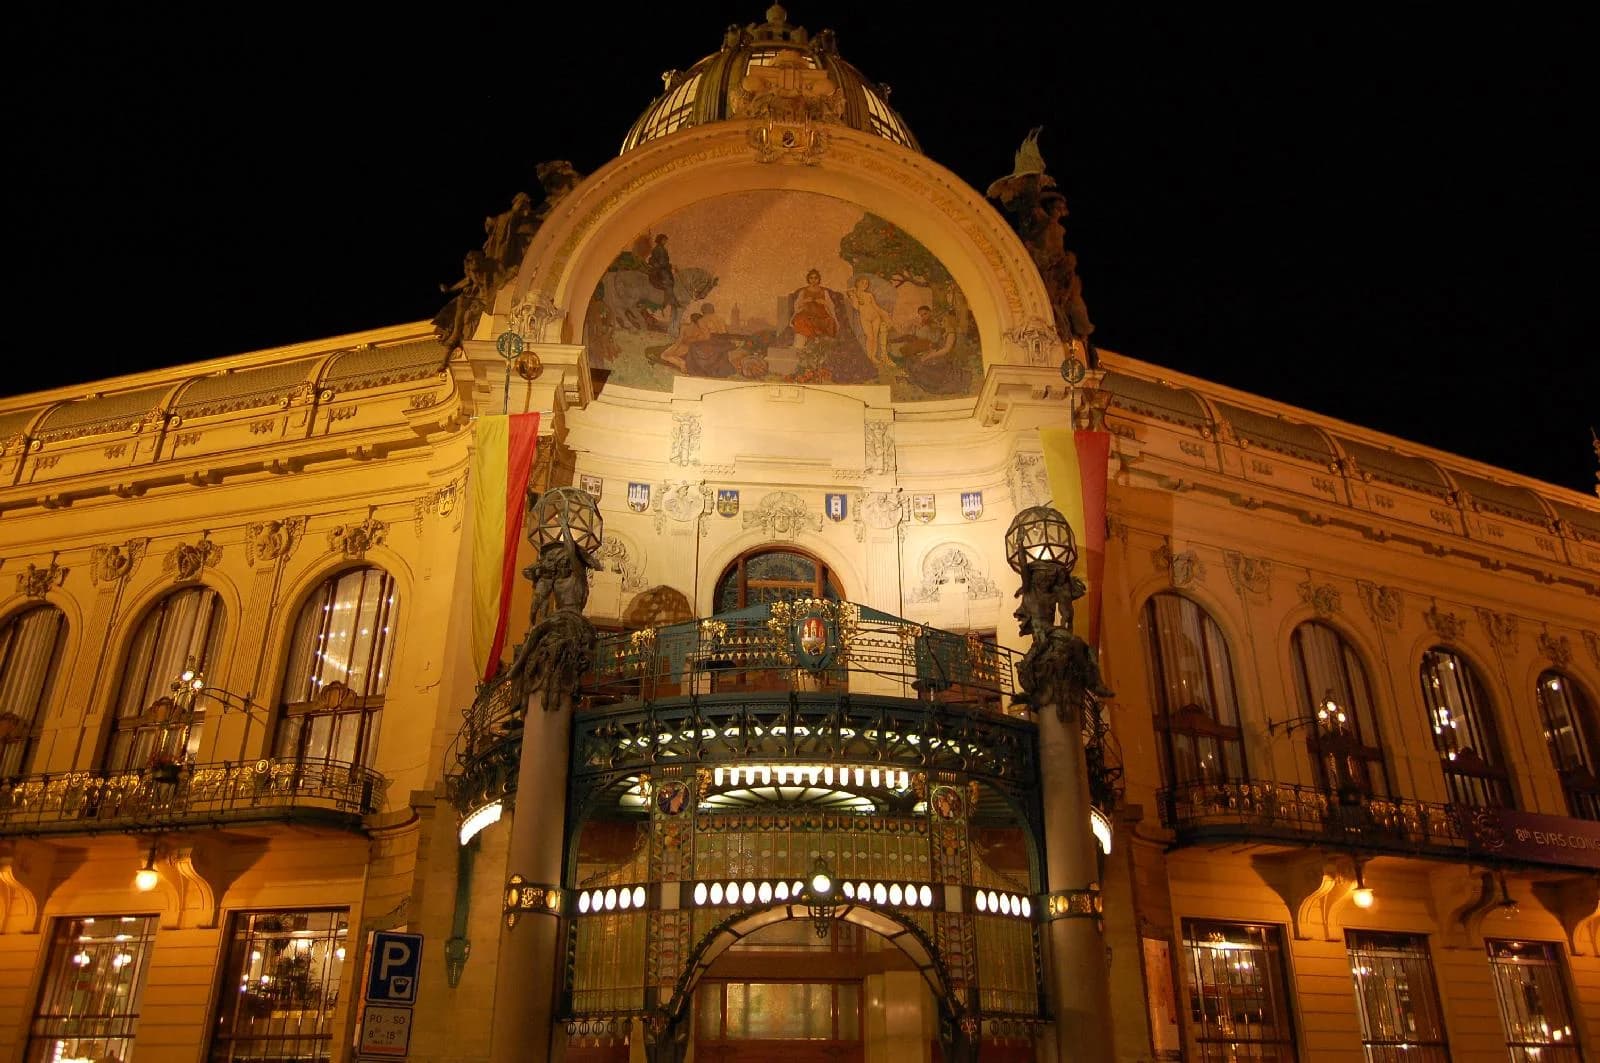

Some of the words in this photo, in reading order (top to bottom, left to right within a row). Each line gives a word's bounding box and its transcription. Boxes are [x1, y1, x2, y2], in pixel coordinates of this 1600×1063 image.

[1515, 828, 1532, 842] 8th
[1534, 831, 1567, 848] EVRS
[379, 940, 411, 981] P
[369, 1014, 383, 1024] PO
[393, 1015, 406, 1025] SO
